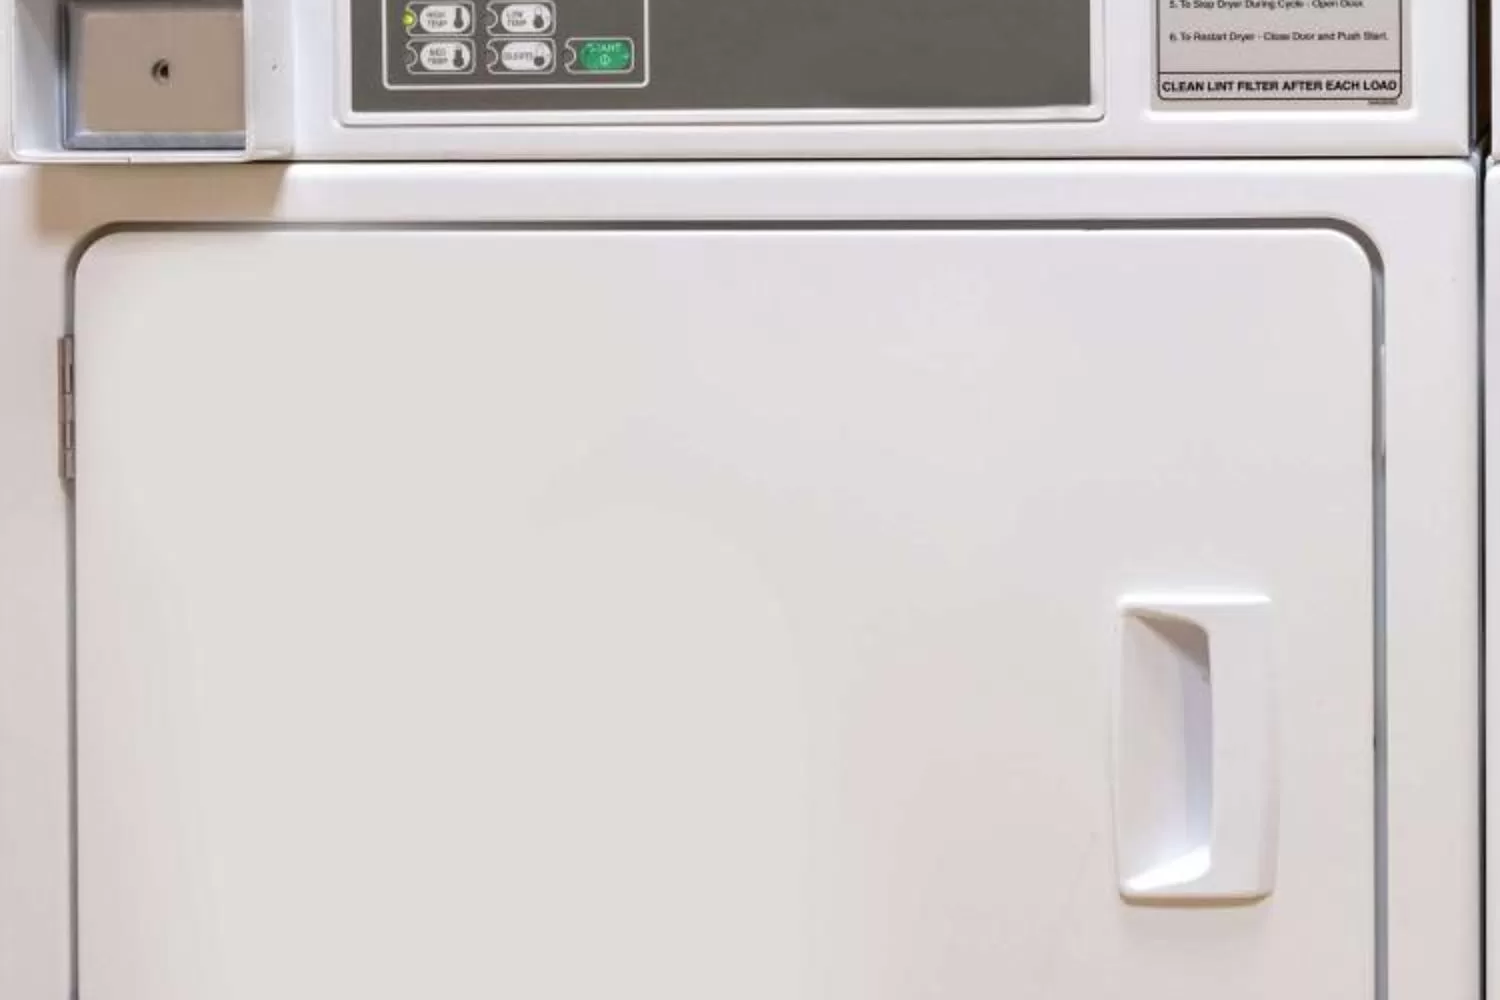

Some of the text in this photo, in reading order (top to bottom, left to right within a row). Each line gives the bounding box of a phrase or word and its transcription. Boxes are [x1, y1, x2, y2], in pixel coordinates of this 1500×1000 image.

[1180, 0, 1191, 9] To
[1193, 0, 1215, 11] Stop
[1217, 0, 1243, 10] Dryer
[1245, 0, 1277, 11] During
[1180, 32, 1192, 41] To
[1193, 32, 1227, 41] Restart
[1229, 31, 1255, 43] Dryer
[1263, 31, 1290, 41] Close
[1291, 31, 1315, 41] Door
[1317, 31, 1336, 41] and
[1337, 31, 1361, 41] Push
[1162, 80, 1397, 93] CLEAN LINT FILTER AFTER EACH LOAD
